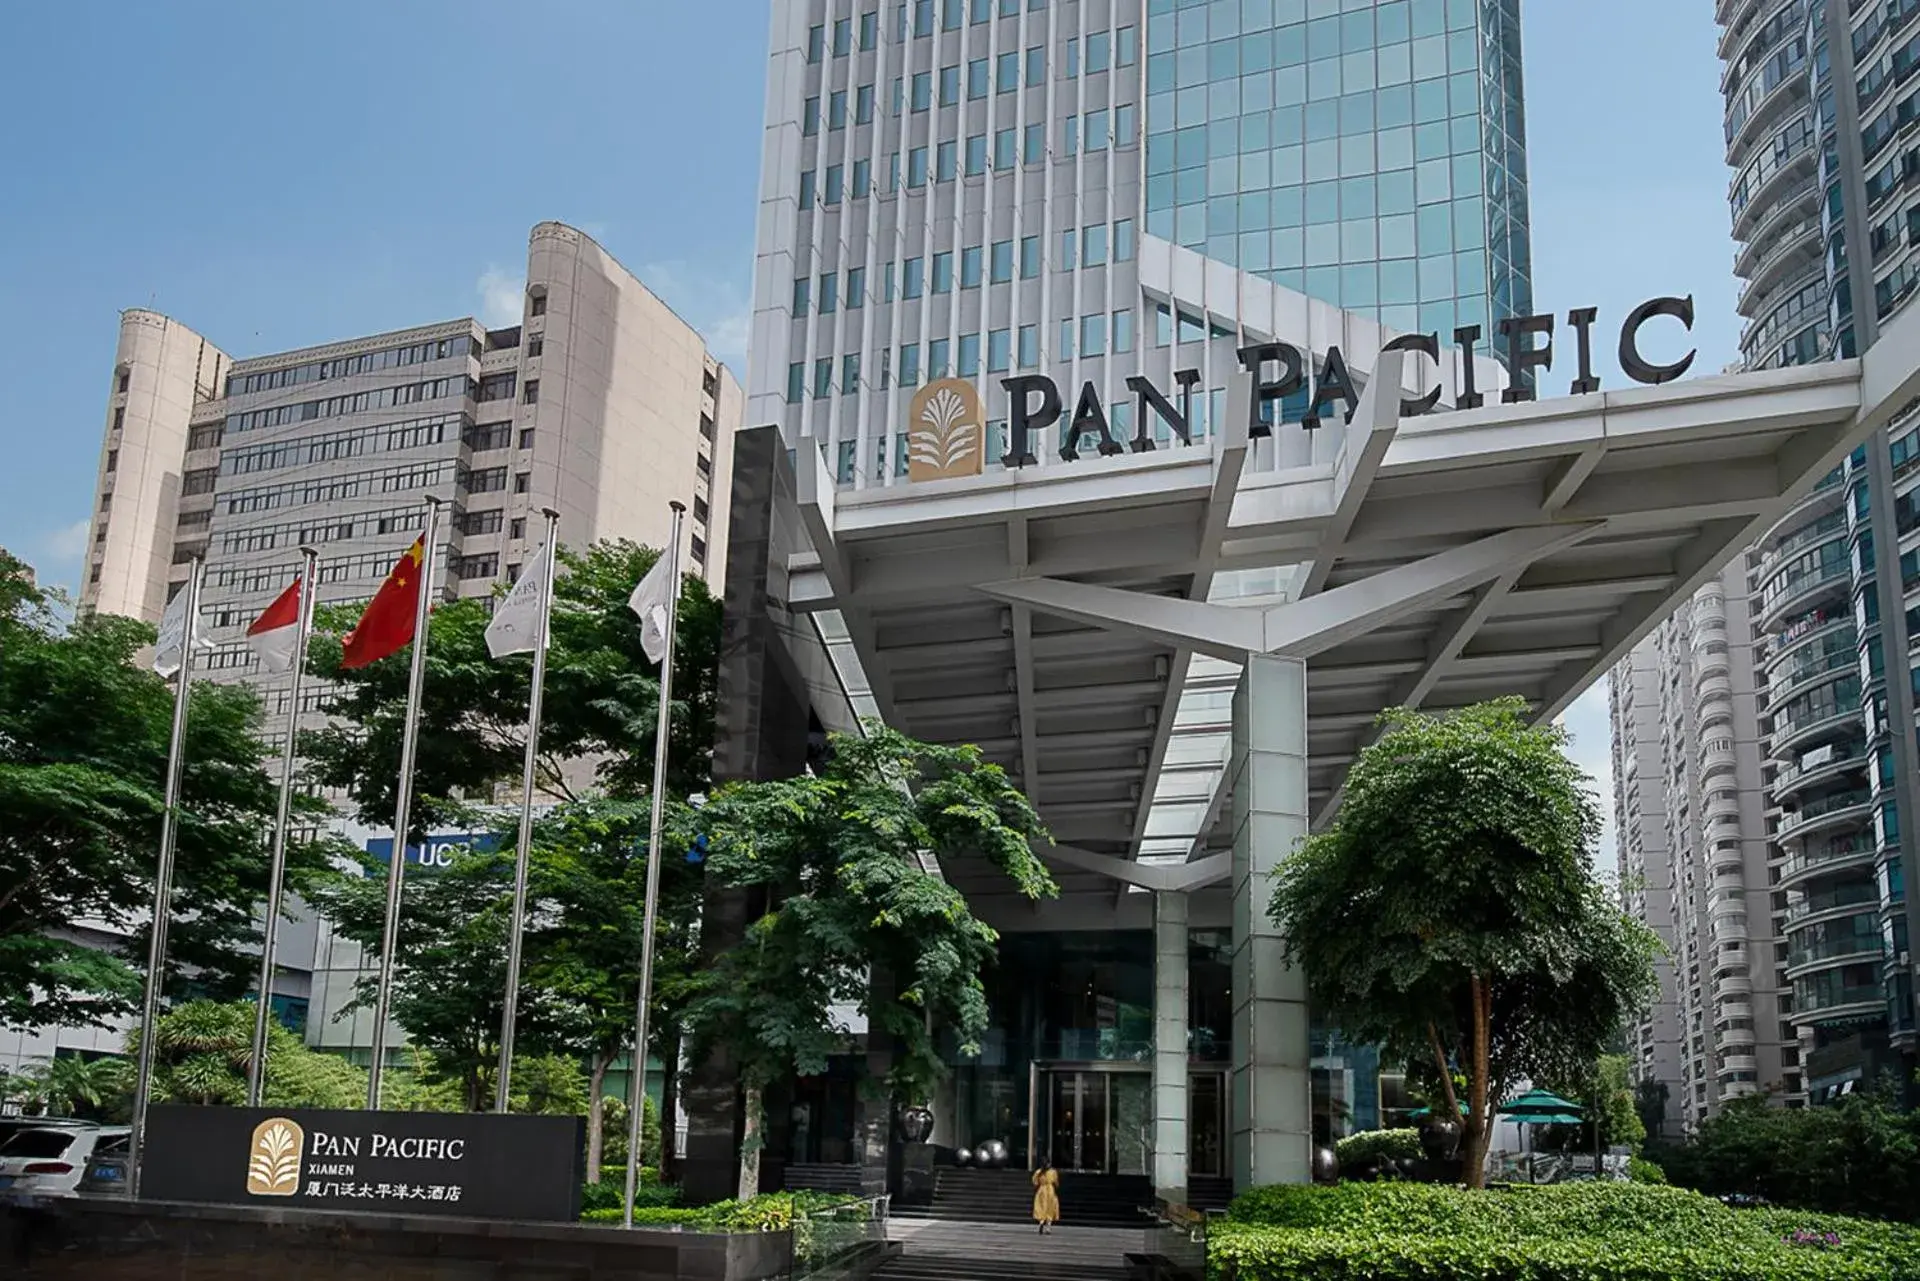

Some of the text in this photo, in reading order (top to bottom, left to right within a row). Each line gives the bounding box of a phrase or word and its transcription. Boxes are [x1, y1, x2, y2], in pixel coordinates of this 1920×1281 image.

[1000, 293, 1697, 469] PAN PACIFIC
[310, 1132, 465, 1160] PAN PACIFIC
[307, 1163, 355, 1176] XIAMEN
[304, 1180, 462, 1201] 厦门泛太平洋大酒店
